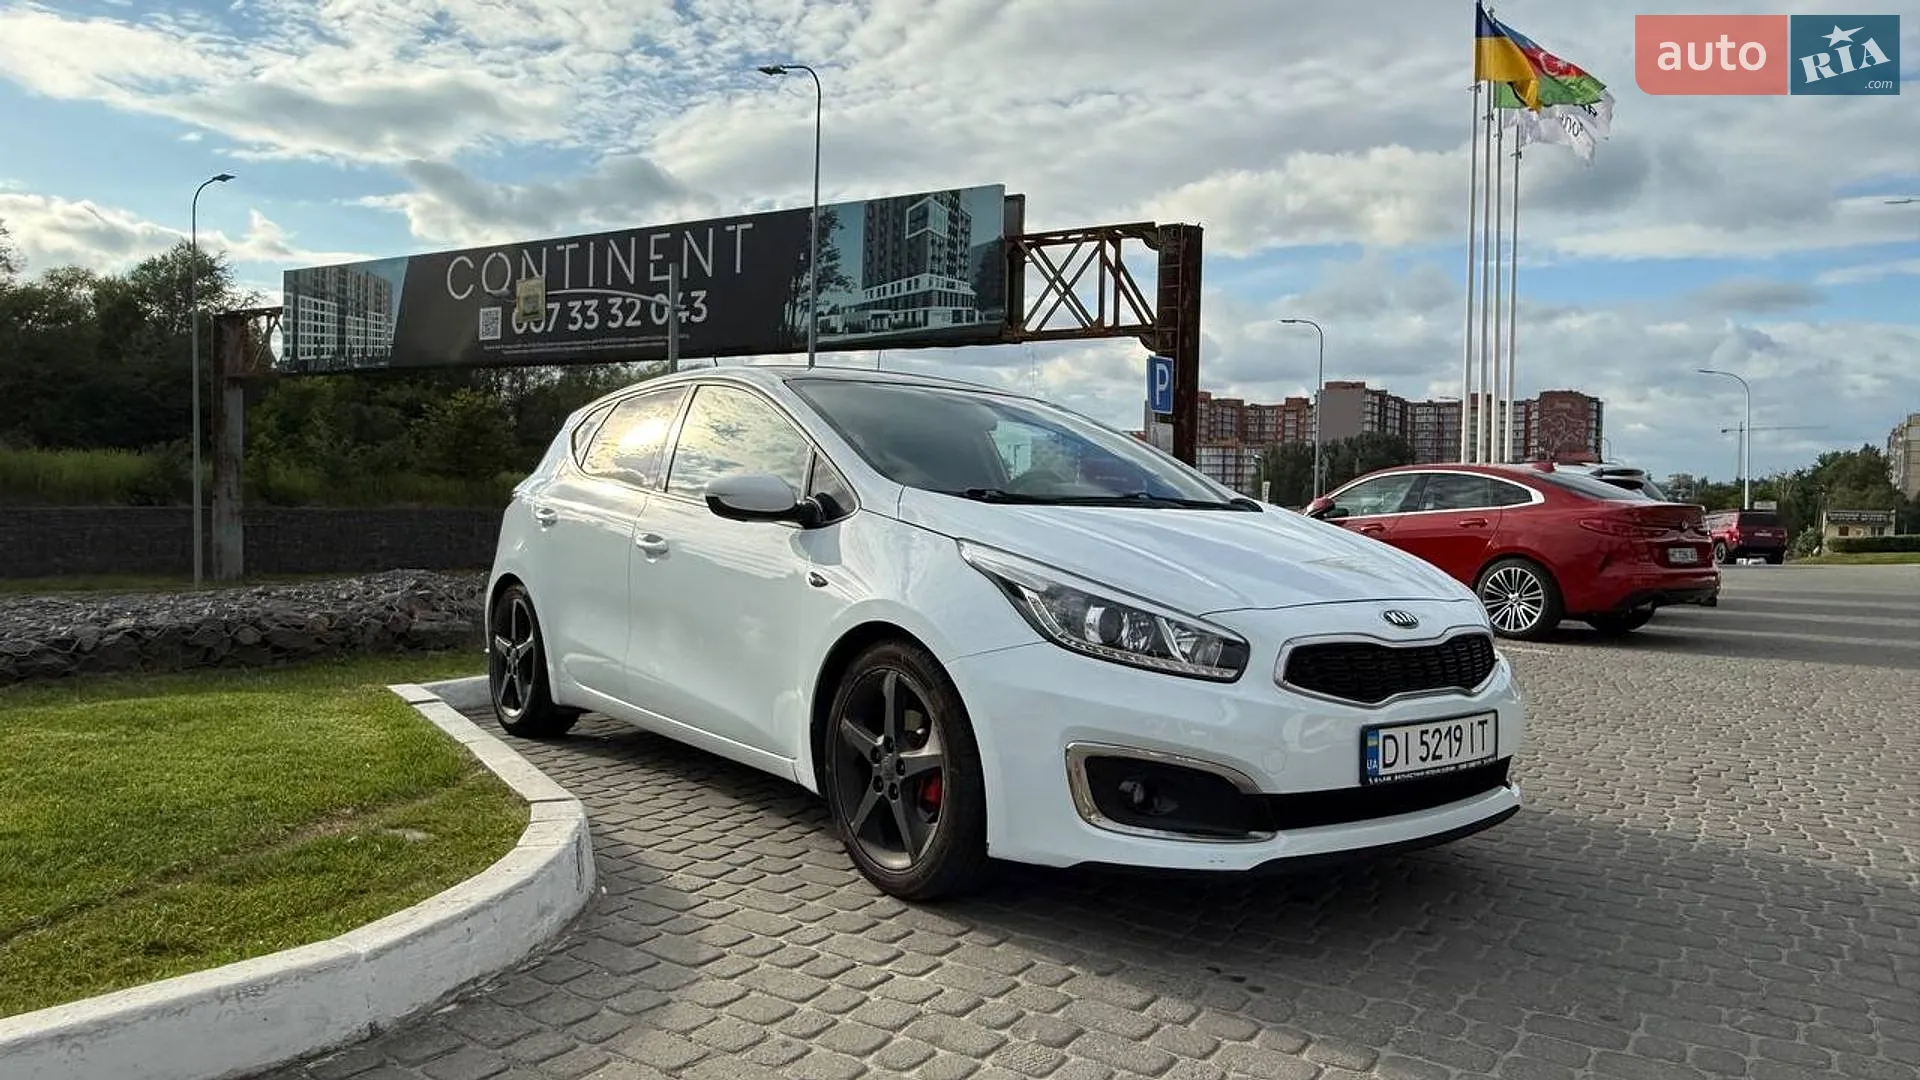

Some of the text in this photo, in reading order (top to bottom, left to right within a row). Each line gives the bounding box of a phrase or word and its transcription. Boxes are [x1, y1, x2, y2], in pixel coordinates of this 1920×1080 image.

[446, 222, 754, 300] CONTINENT
[567, 299, 599, 331] 33
[607, 297, 642, 328] 32
[1156, 363, 1169, 406] P
[1386, 611, 1417, 624] KIA
[1382, 719, 1488, 769] DI 5219 IT
[1367, 758, 1378, 770] UA
